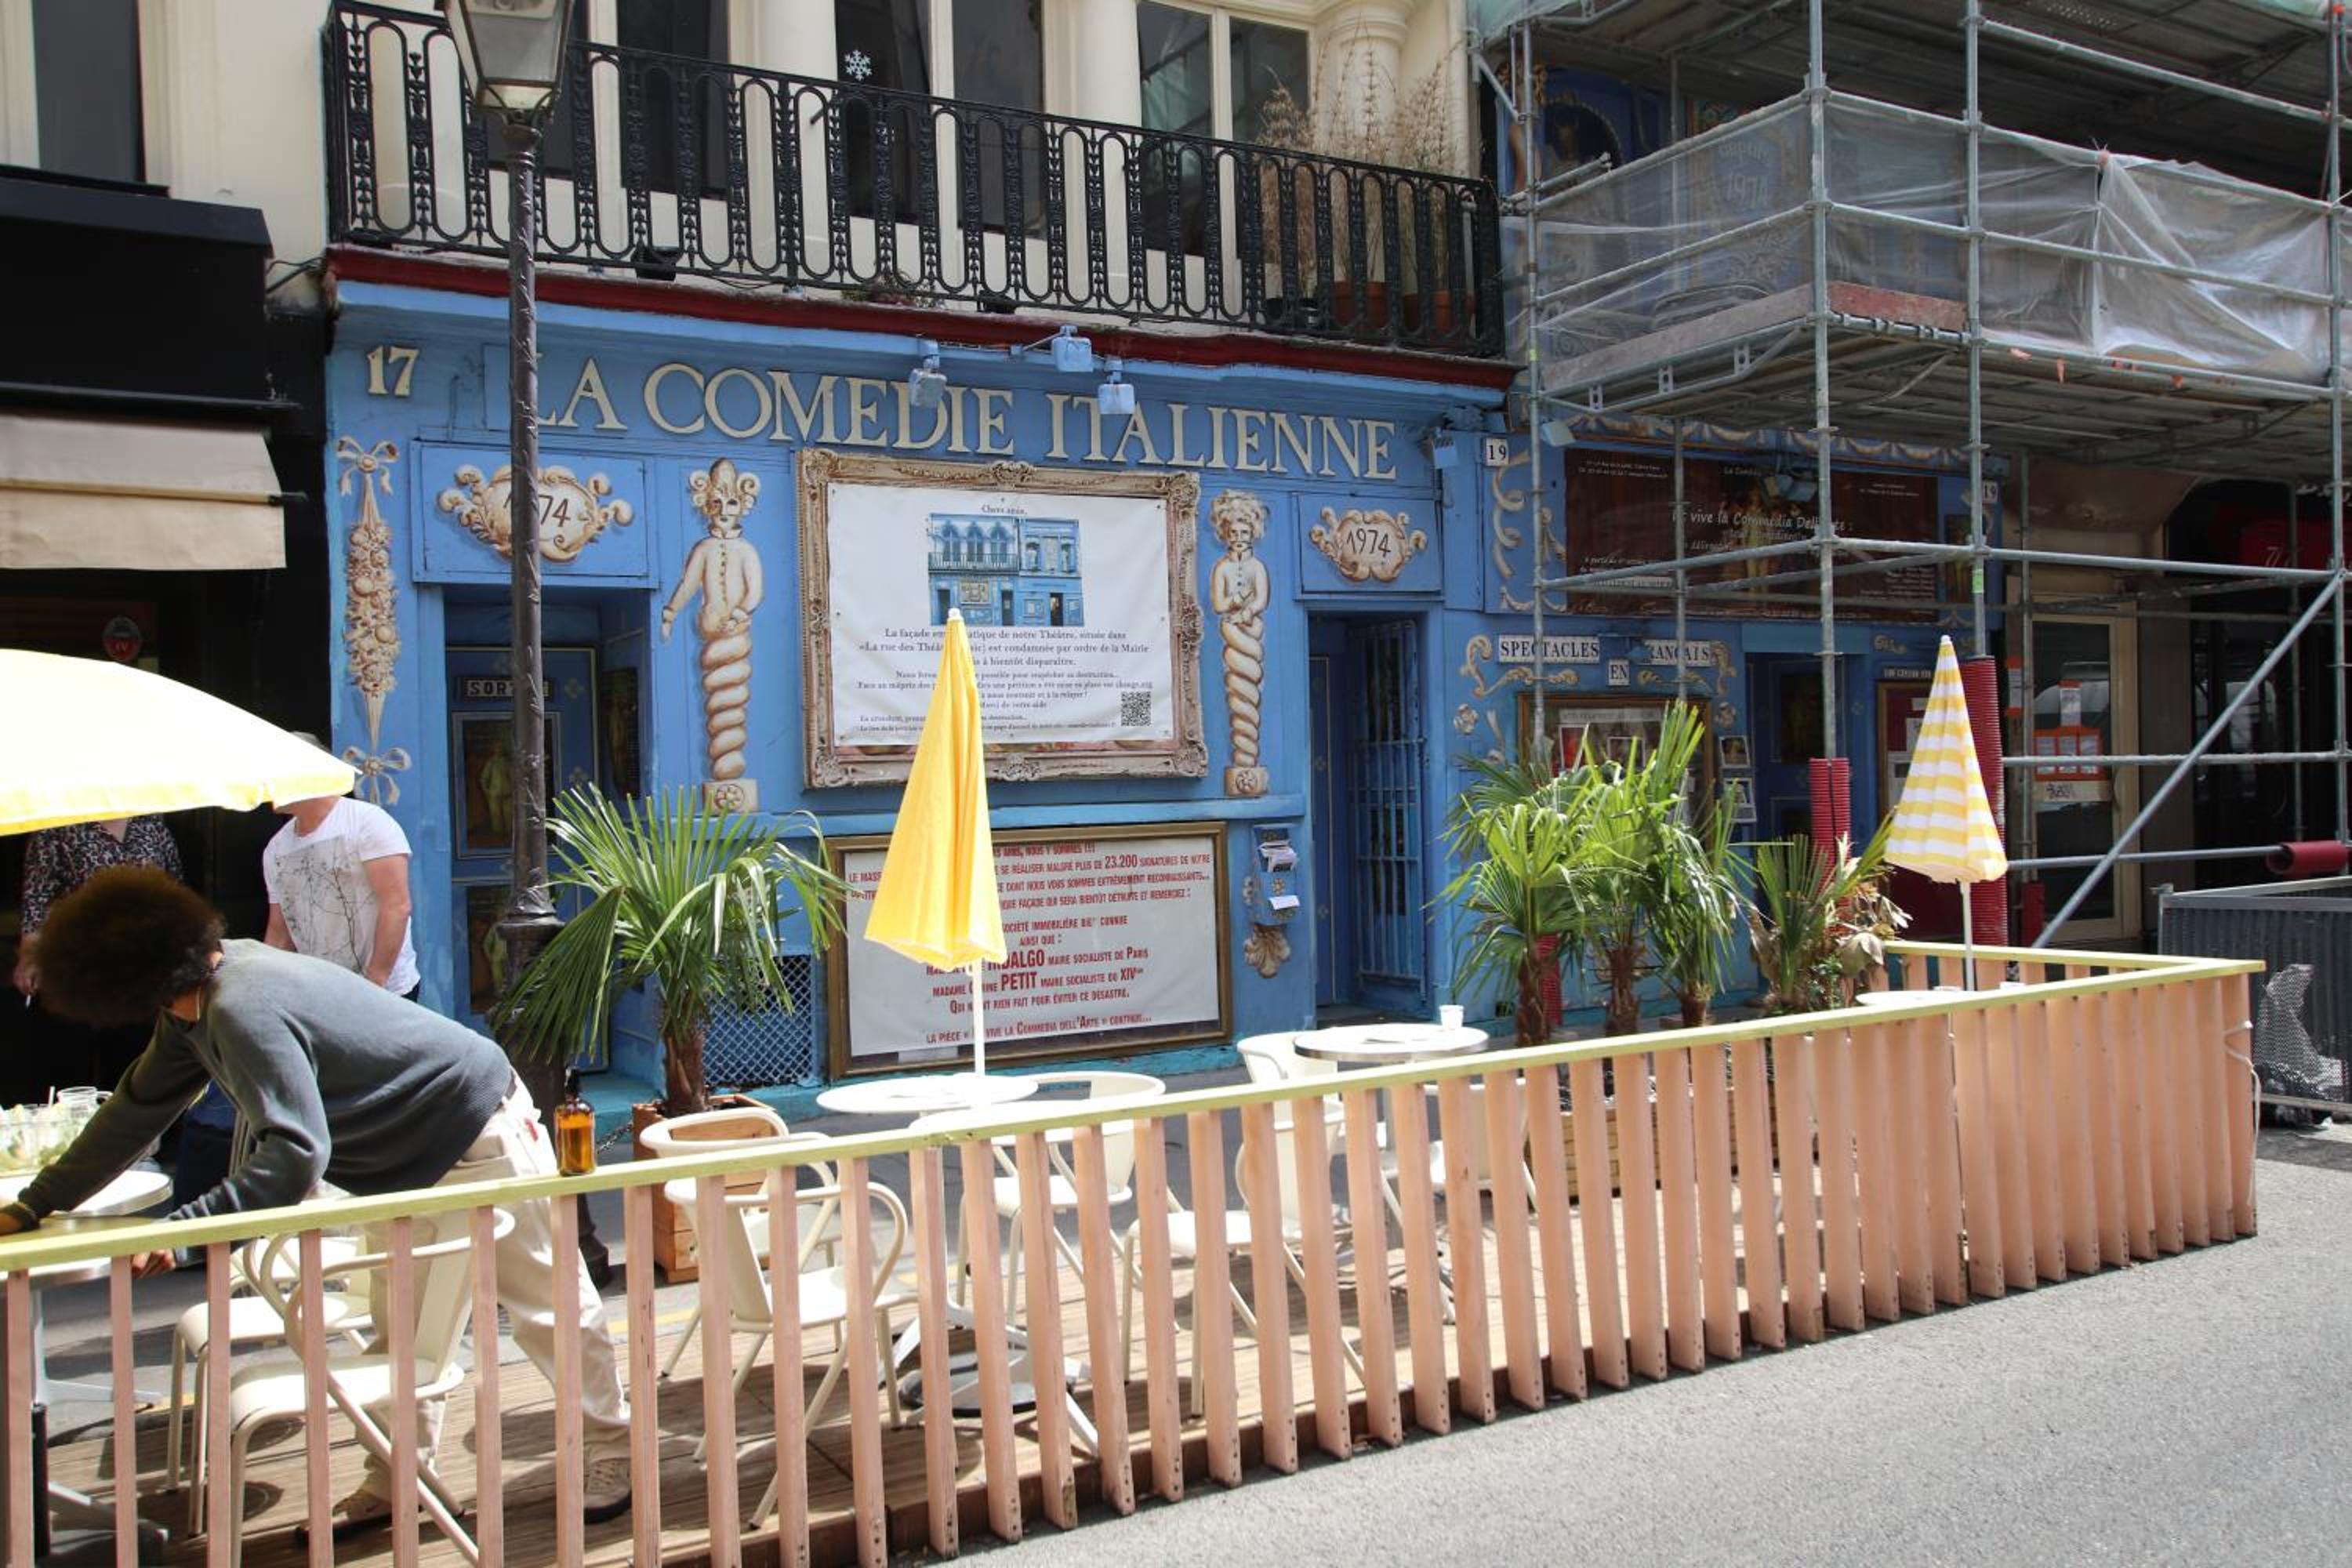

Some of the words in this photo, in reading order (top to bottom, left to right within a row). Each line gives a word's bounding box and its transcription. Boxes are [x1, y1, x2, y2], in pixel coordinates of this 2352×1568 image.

[366, 346, 420, 397] 17
[644, 363, 1014, 456] COMEDIE
[1046, 394, 1397, 481] ITALIENNE
[1488, 445, 1507, 460] 19
[1690, 513, 1714, 524] vive
[1346, 528, 1392, 557] 1974
[885, 629, 898, 637] La
[899, 629, 931, 640] façade
[999, 630, 1009, 639] de
[1108, 630, 1127, 639] dans
[898, 642, 914, 652] des
[1004, 644, 1054, 653] condamnée
[1073, 644, 1098, 652] ordre
[1100, 644, 1109, 652] de
[1111, 643, 1119, 653] la
[1121, 644, 1149, 653] Mairie
[990, 656, 1024, 666] bientôt
[1025, 656, 1076, 668] disparaître.
[1611, 664, 1628, 680] EN
[1000, 865, 1010, 874] SE
[1075, 860, 1092, 870] PLUS
[1094, 859, 1102, 869] DE
[1105, 854, 1138, 869] 23.200
[1180, 855, 1189, 865] DE
[1006, 880, 1025, 891] DONT
[1026, 880, 1045, 891] NOUS
[1047, 878, 1065, 889] VOUS
[1067, 877, 1095, 888] SOMMES
[1018, 897, 1044, 909] FAÇADE
[1059, 895, 1077, 906] SERA
[1141, 891, 1148, 901] ET
[1020, 935, 1039, 946] AINSI
[1040, 935, 1054, 946] QUE
[1048, 954, 1071, 965] MAIRE
[1073, 951, 1112, 964] SOCIALISTE
[932, 985, 967, 997] MADAME
[1001, 971, 1037, 991] PETIT
[993, 998, 1011, 1010] RIEN
[1014, 996, 1029, 1007] FAIT
[1031, 995, 1051, 1006] POUR
[1080, 992, 1090, 1002] CE
[927, 1033, 937, 1044] LA
[985, 1027, 1002, 1037] VIVE
[1004, 1026, 1014, 1036] LA
